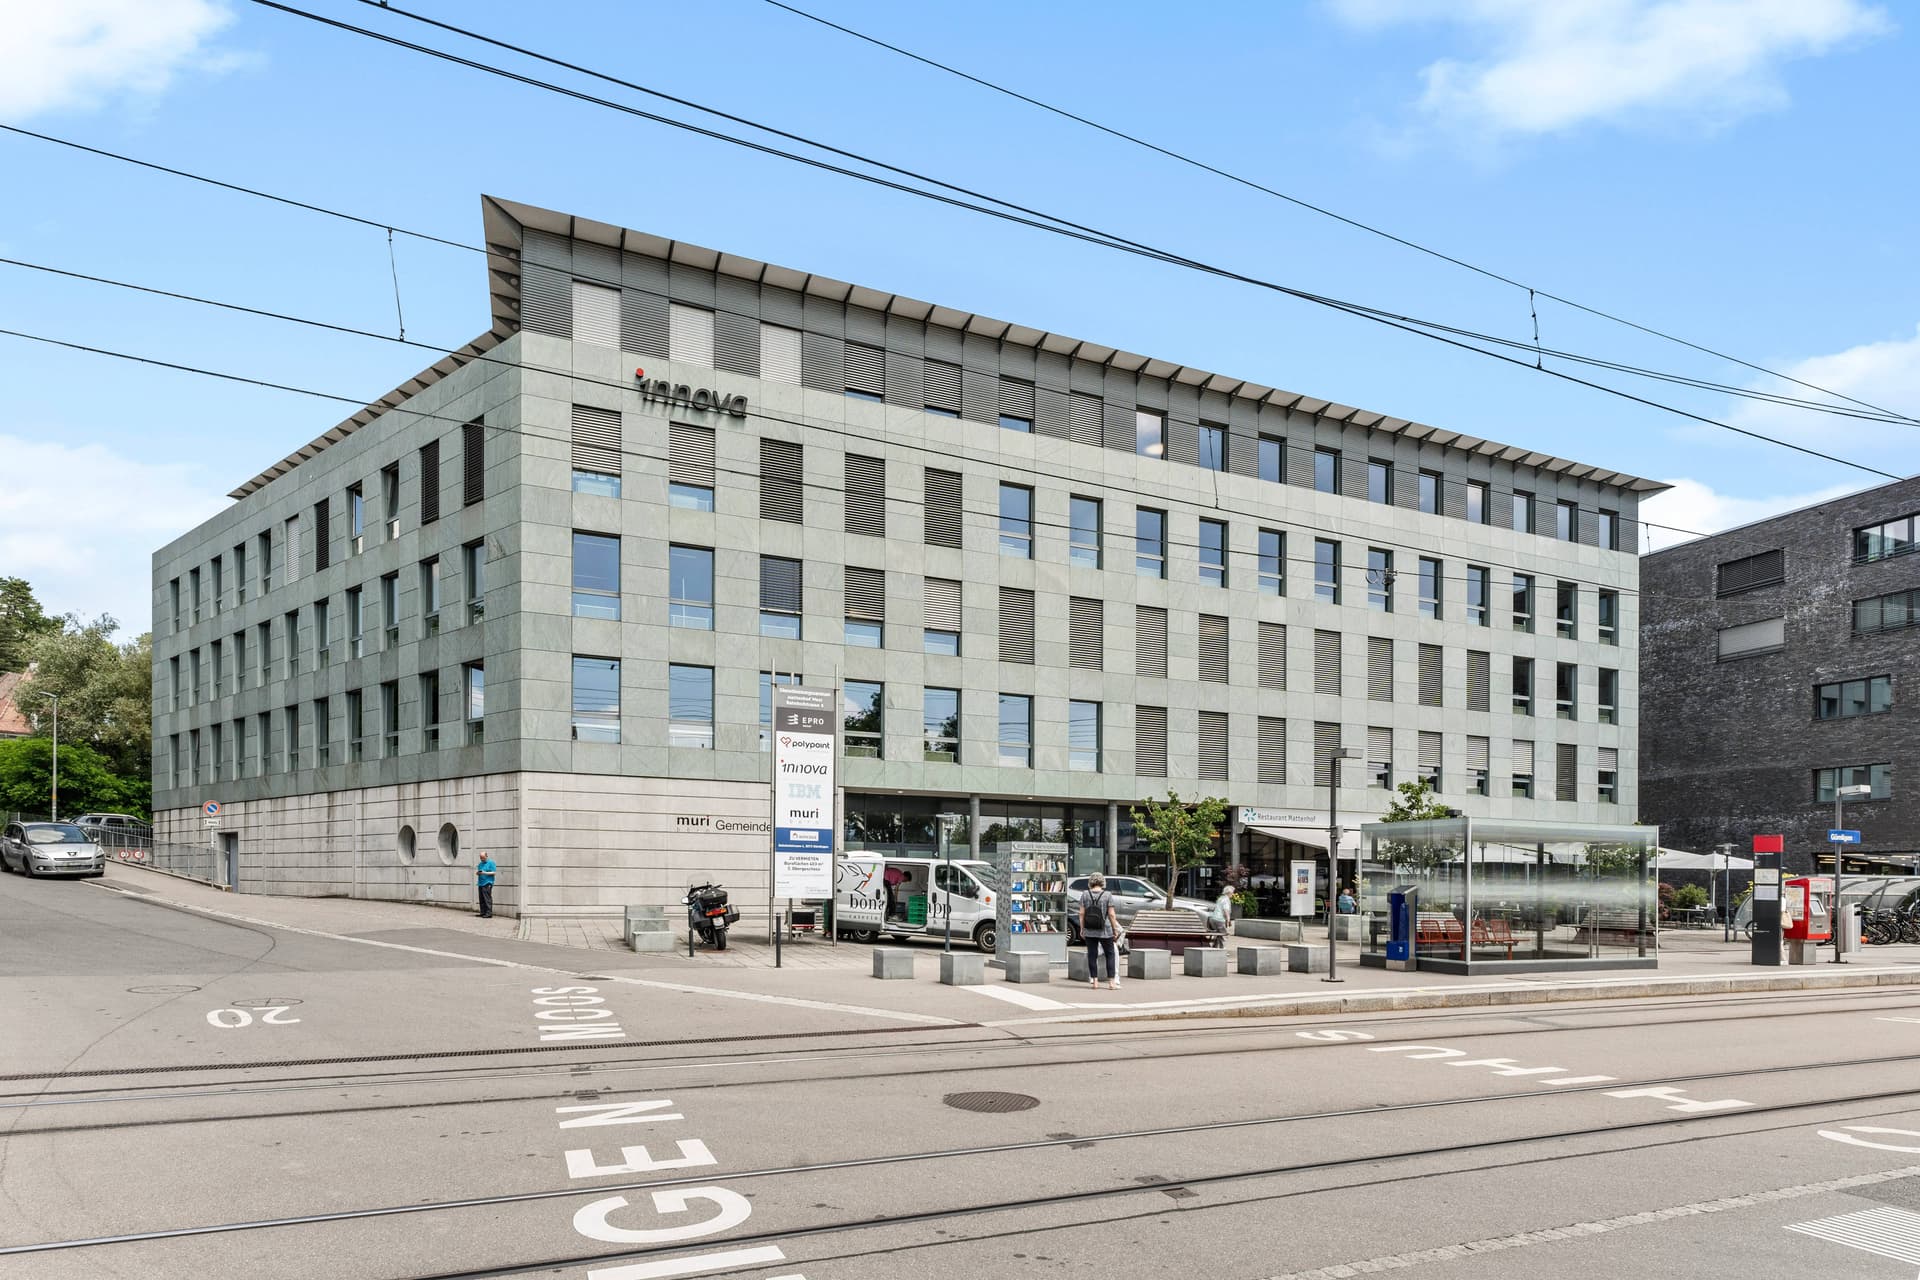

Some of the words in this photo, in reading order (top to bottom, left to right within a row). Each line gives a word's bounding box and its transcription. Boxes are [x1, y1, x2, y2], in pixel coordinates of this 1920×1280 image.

[636, 367, 748, 418] innova
[802, 717, 825, 725] EPRO
[792, 740, 830, 749] polypoint
[781, 759, 828, 775] innova
[788, 783, 822, 799] IBM
[790, 808, 819, 818] muri
[1258, 813, 1287, 822] Restaurant
[1288, 814, 1316, 823] Mattenhof
[677, 815, 710, 826] muri
[715, 819, 772, 832] Gemeinde
[206, 1005, 302, 1029] 20
[530, 986, 627, 1041] MOOS
[555, 1099, 806, 1280] IGEN
